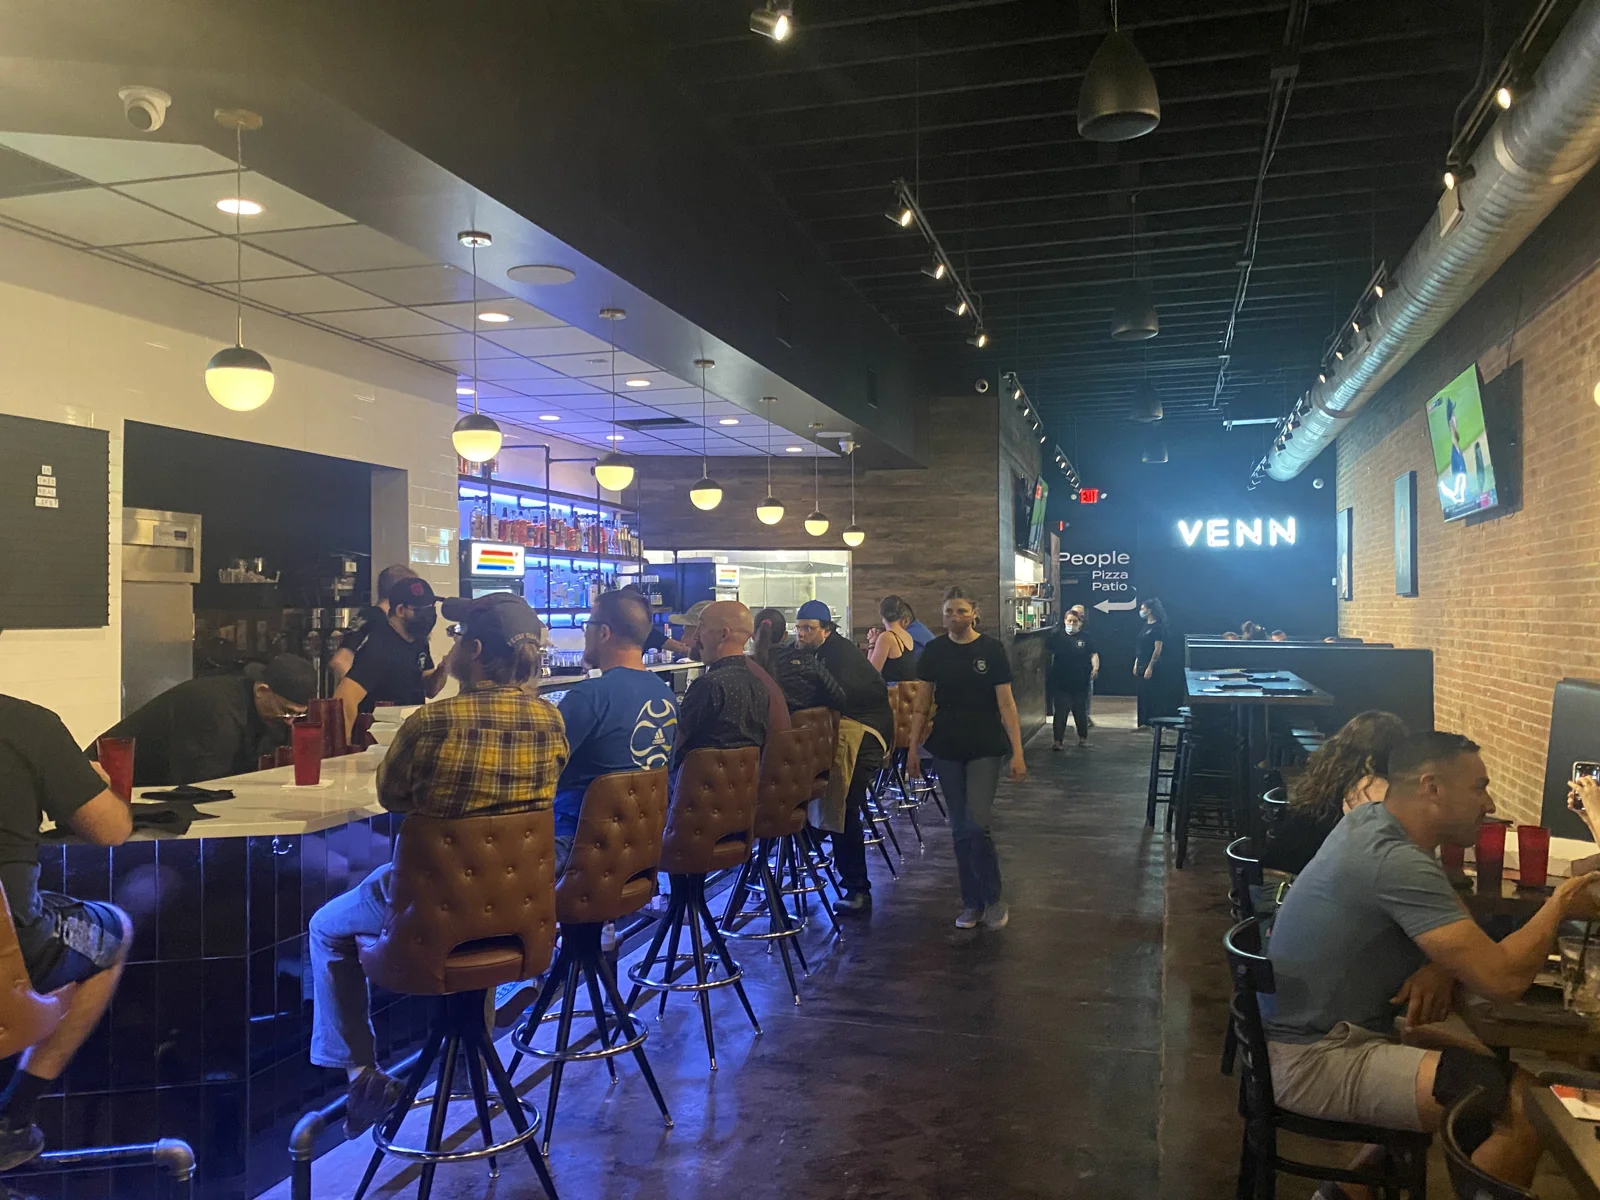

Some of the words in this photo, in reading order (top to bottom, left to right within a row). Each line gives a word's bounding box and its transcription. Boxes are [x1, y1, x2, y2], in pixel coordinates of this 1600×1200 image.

[1080, 489, 1099, 504] EXIT
[1178, 517, 1296, 547] VENN
[1059, 551, 1130, 567] People
[1092, 570, 1128, 580] Pizza
[1092, 581, 1128, 591] Patio
